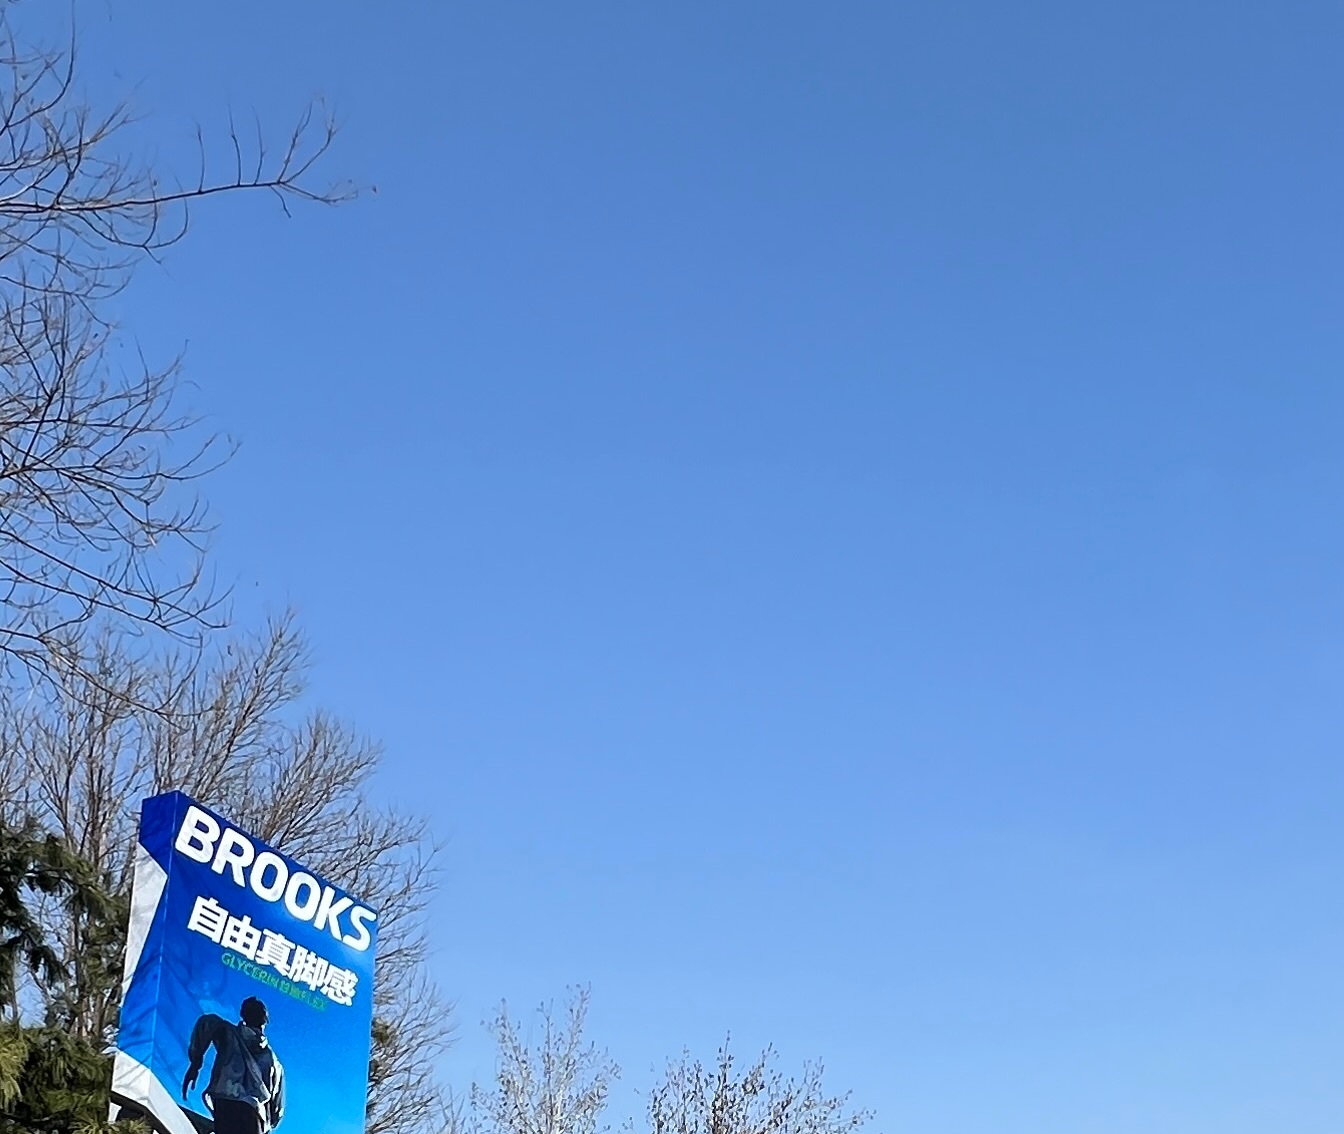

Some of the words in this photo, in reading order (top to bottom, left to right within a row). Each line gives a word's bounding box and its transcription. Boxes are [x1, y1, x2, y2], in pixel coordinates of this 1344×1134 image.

[175, 805, 376, 952] BROOKS
[187, 896, 359, 1007] 自由真脚感
